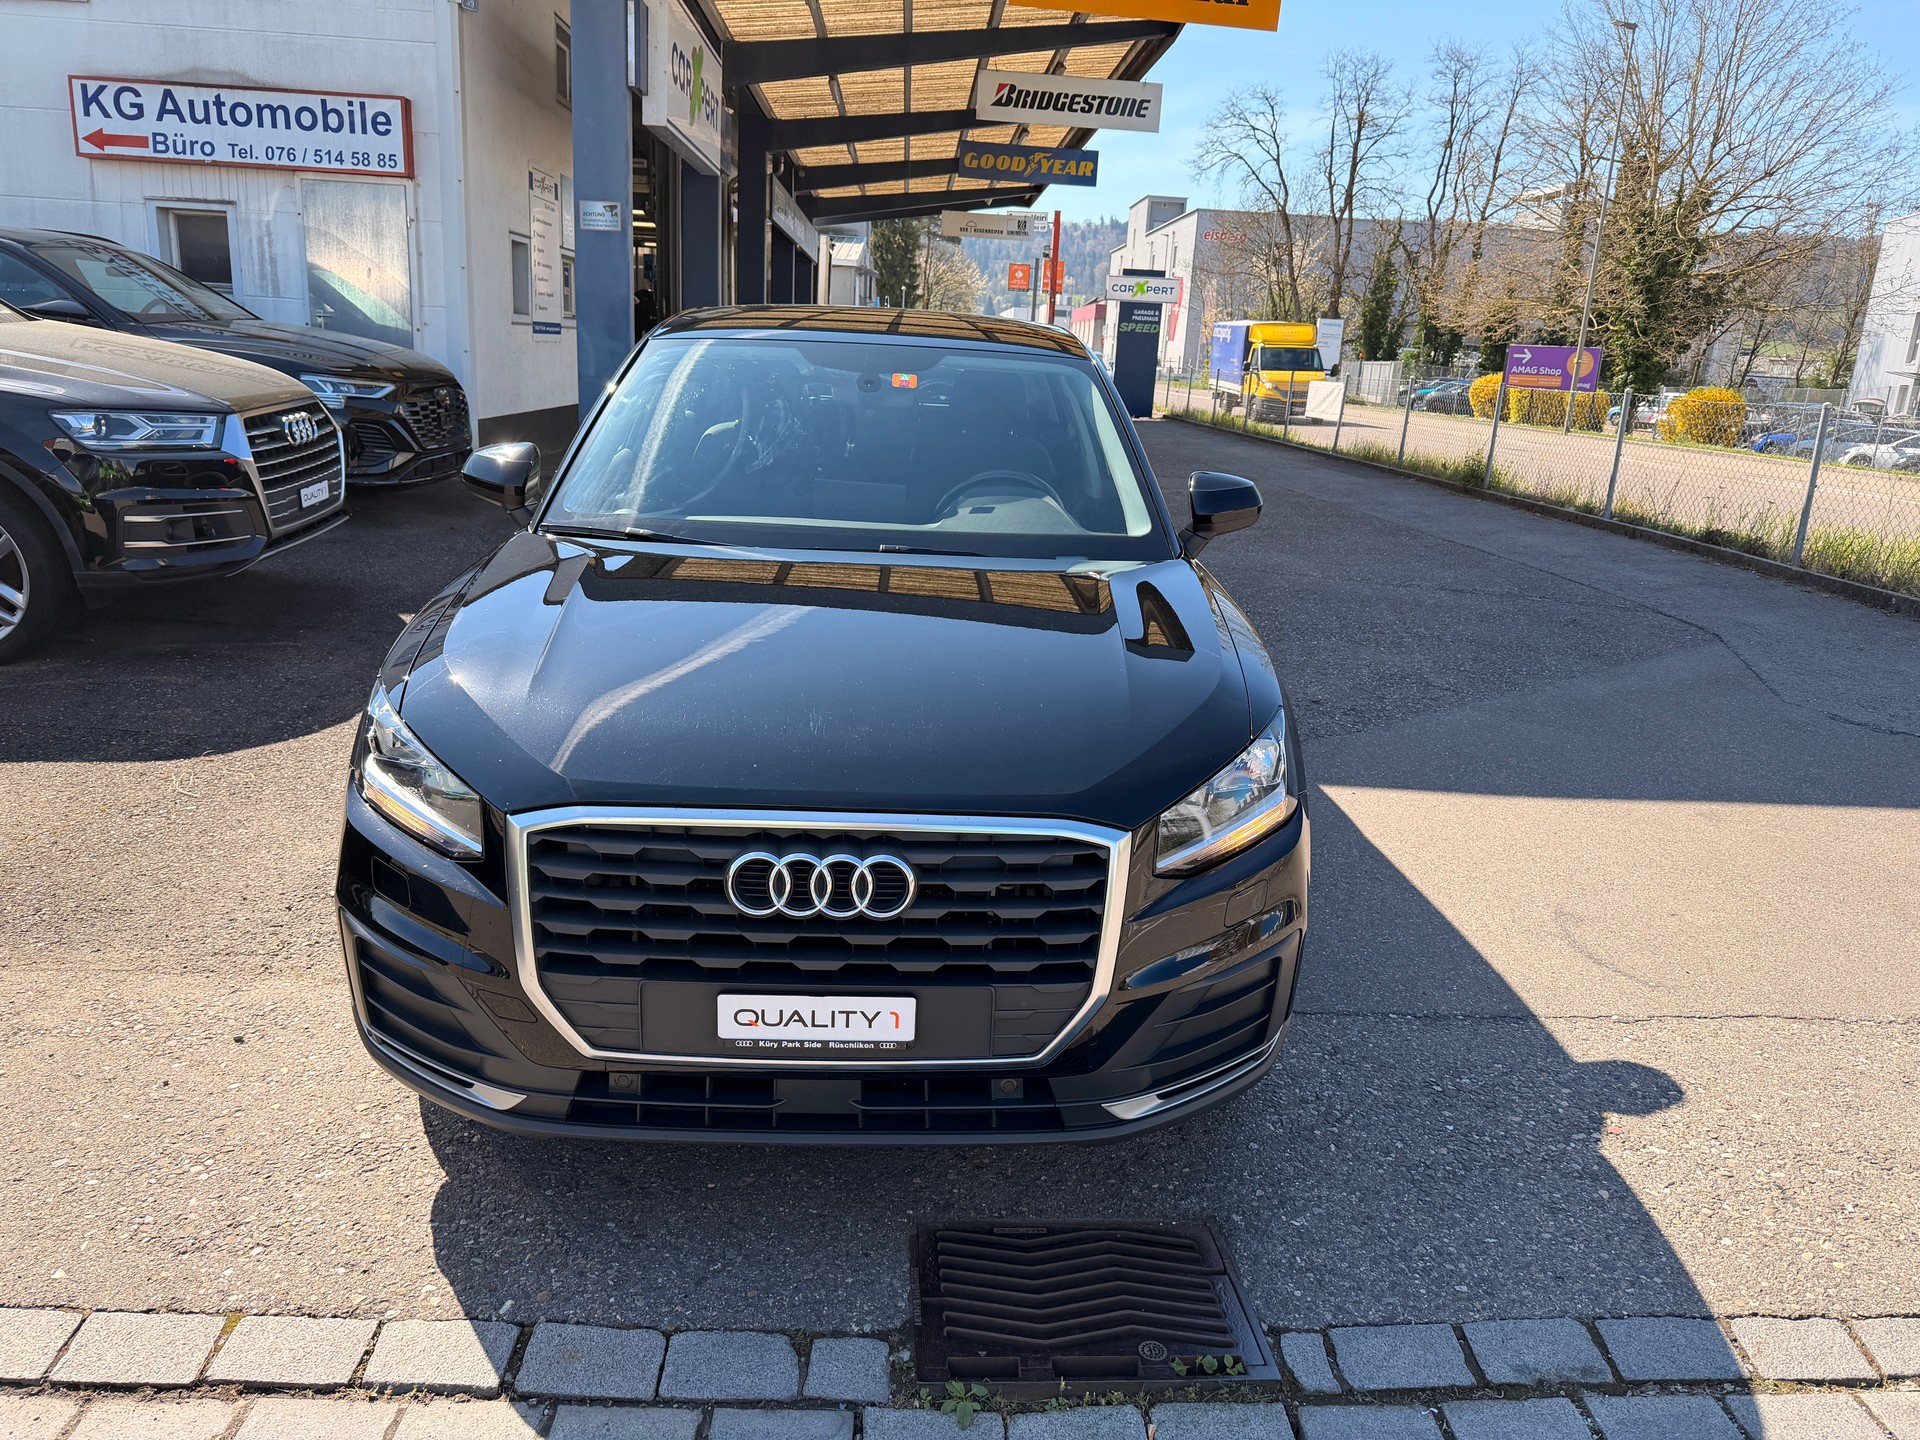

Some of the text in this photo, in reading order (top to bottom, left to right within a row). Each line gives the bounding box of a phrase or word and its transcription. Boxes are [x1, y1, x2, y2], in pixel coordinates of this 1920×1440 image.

[81, 83, 393, 137] KG Automobile
[990, 83, 1151, 118] BRIDGESTONE
[152, 131, 398, 169] Büro Tel. 076 / 514 58 85
[1119, 323, 1159, 333] SPEED
[1511, 366, 1561, 376] AMAG Shop
[734, 1008, 900, 1029] QUALITY 1
[829, 1041, 874, 1049] Rüschlikon
